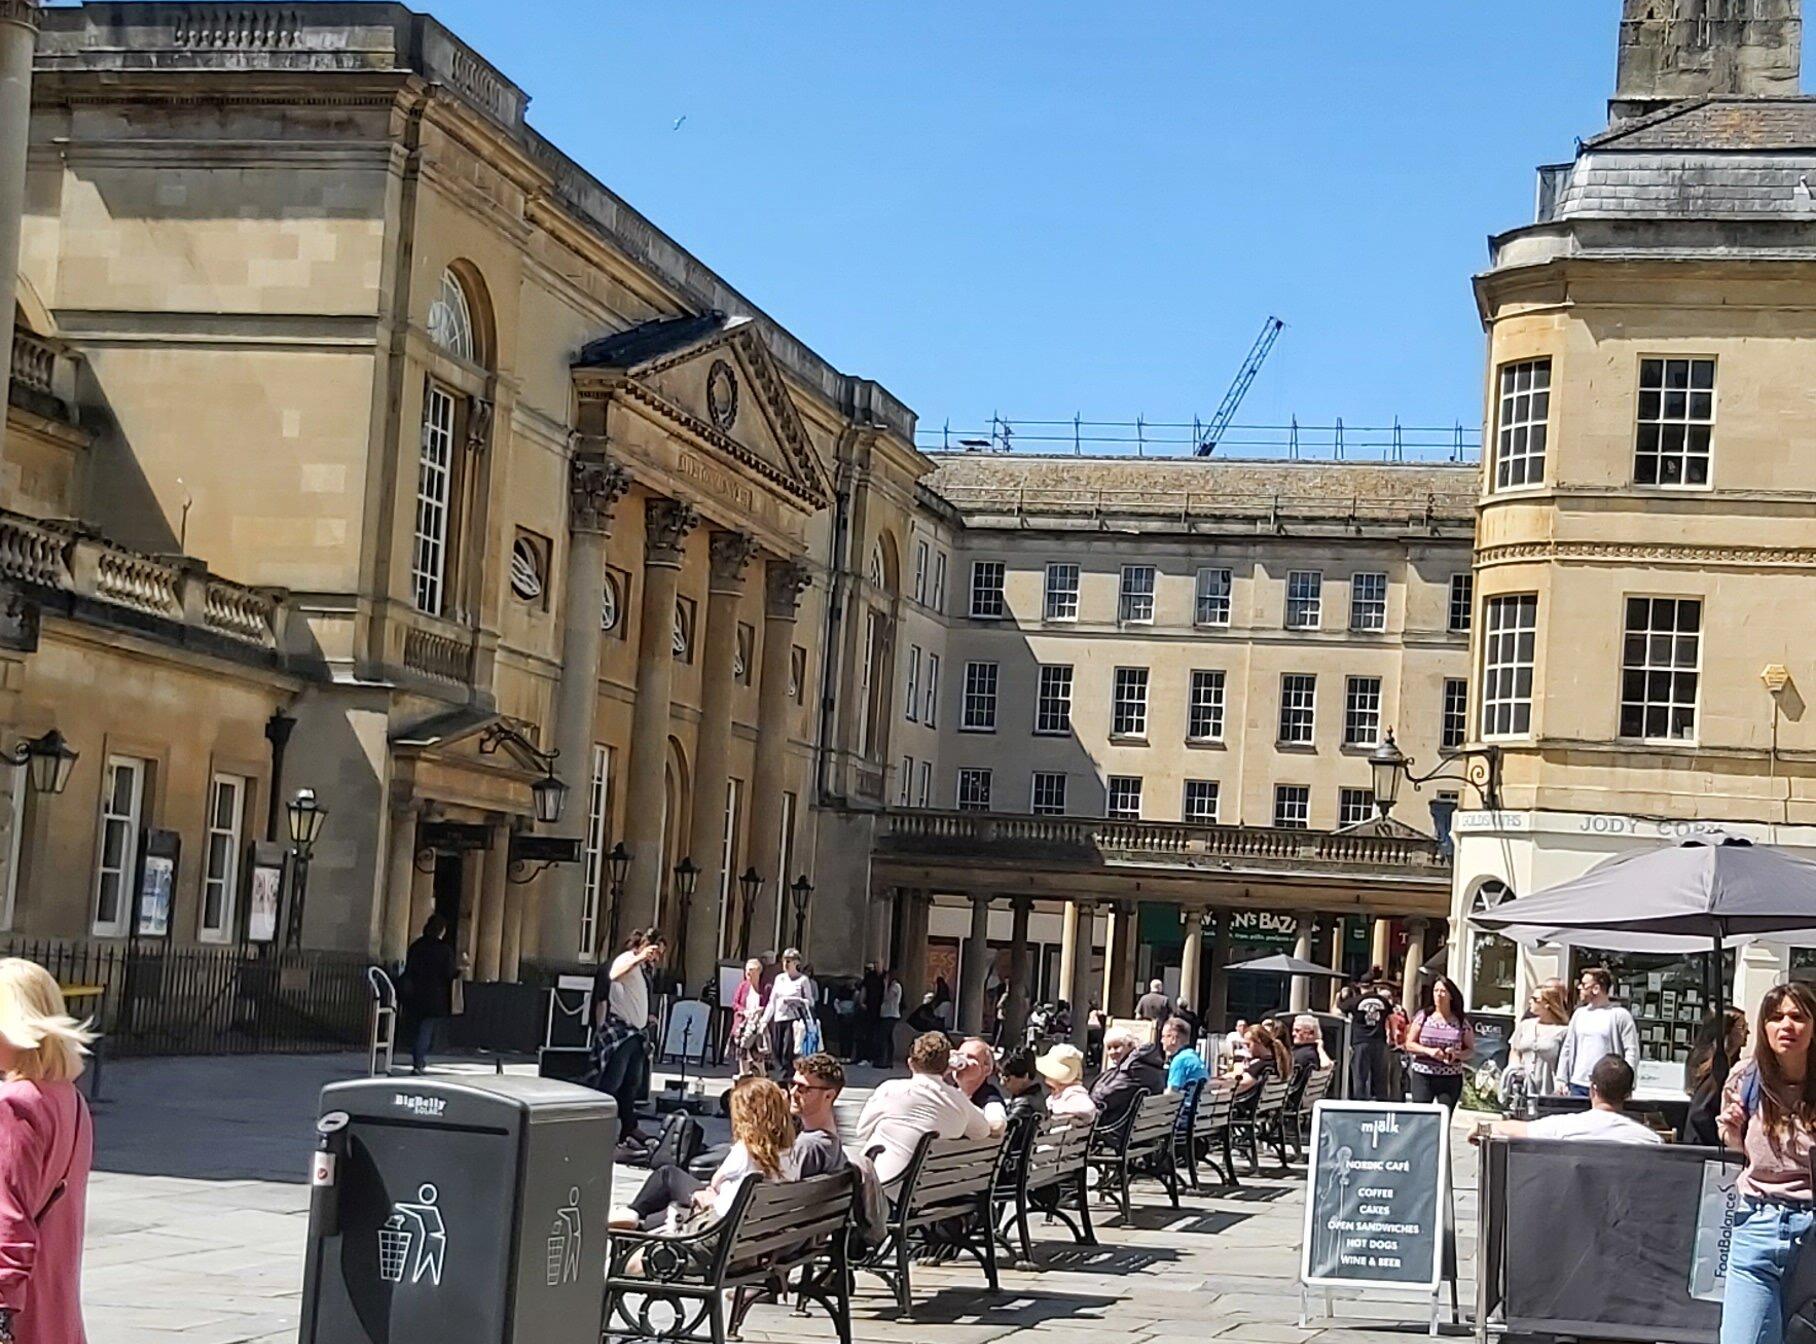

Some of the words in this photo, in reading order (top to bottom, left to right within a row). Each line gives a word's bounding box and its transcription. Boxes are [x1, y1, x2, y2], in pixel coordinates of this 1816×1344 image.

[1579, 815, 1640, 835] JODY
[395, 1094, 447, 1111] BigBelly
[1345, 1160, 1384, 1171] NORDIC
[1385, 1159, 1410, 1172] CAFÉ
[1357, 1187, 1394, 1199] COFFEE
[1359, 1204, 1391, 1216] CAKES
[1327, 1220, 1355, 1231] OPEN
[1355, 1221, 1420, 1235] SANDWICHES
[1714, 1192, 1737, 1279] FootBalance
[1346, 1238, 1367, 1249] HOT
[1369, 1239, 1398, 1251] DOGS
[1340, 1254, 1367, 1266] WINE
[1368, 1256, 1377, 1267] &
[1378, 1257, 1402, 1269] BEER
